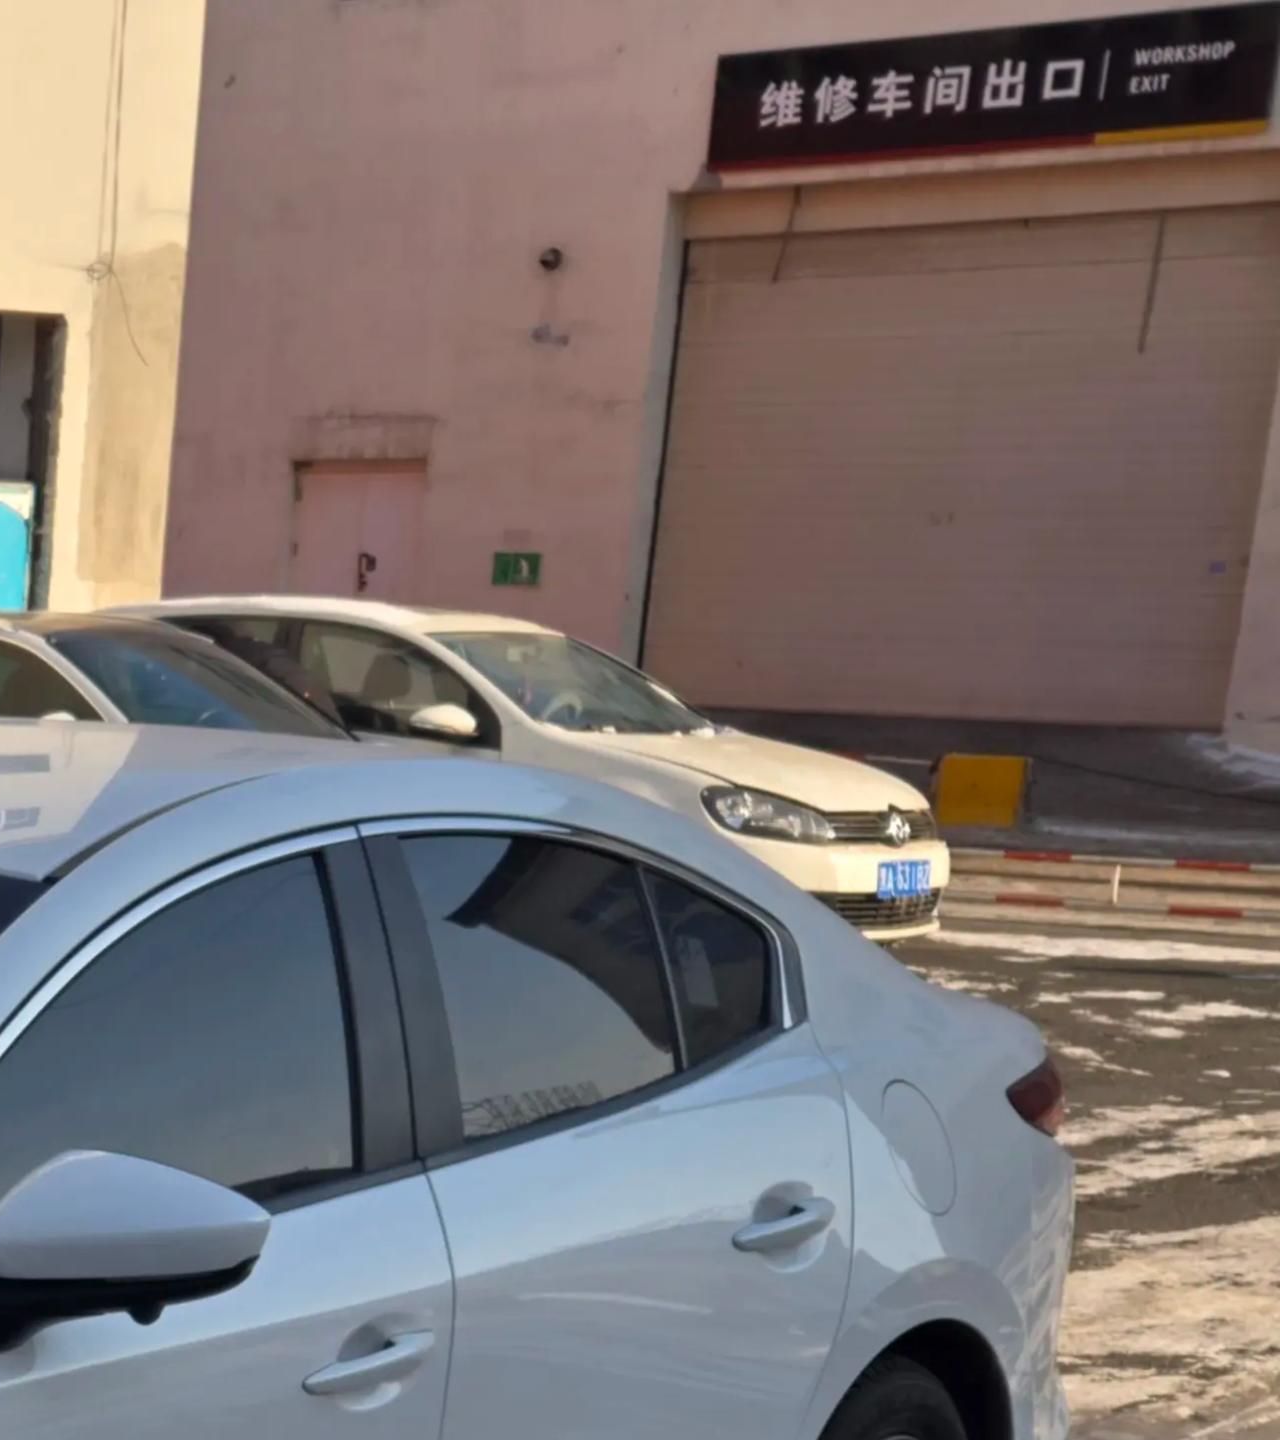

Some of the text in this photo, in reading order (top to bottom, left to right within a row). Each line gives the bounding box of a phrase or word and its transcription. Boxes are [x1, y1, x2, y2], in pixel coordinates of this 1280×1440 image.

[1134, 40, 1235, 66] WORKSHOP
[759, 58, 1085, 127] 维修车间出口
[1129, 73, 1171, 94] EXIT
